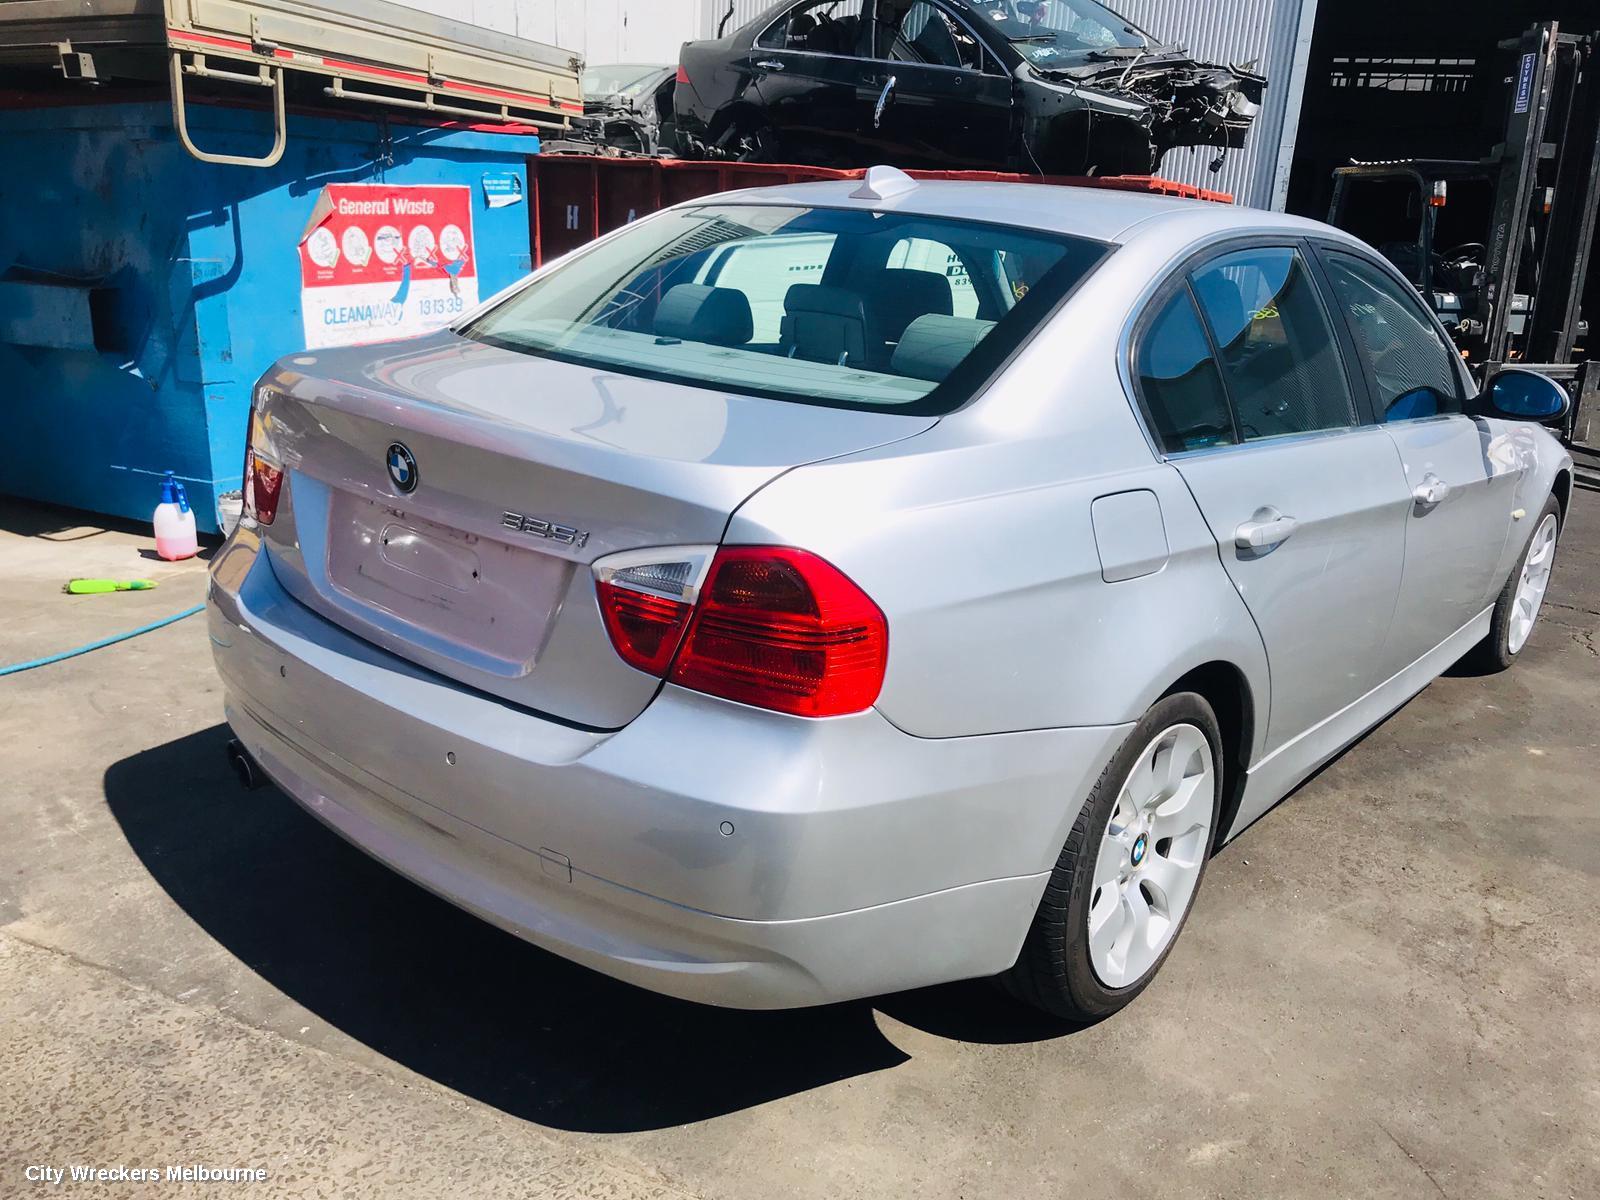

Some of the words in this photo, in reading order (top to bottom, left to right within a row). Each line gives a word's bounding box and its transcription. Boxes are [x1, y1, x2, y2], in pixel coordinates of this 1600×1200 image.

[338, 198, 390, 215] General
[392, 198, 435, 215] Waste
[323, 302, 399, 325] CLEANAWAY
[502, 510, 590, 548] 325i
